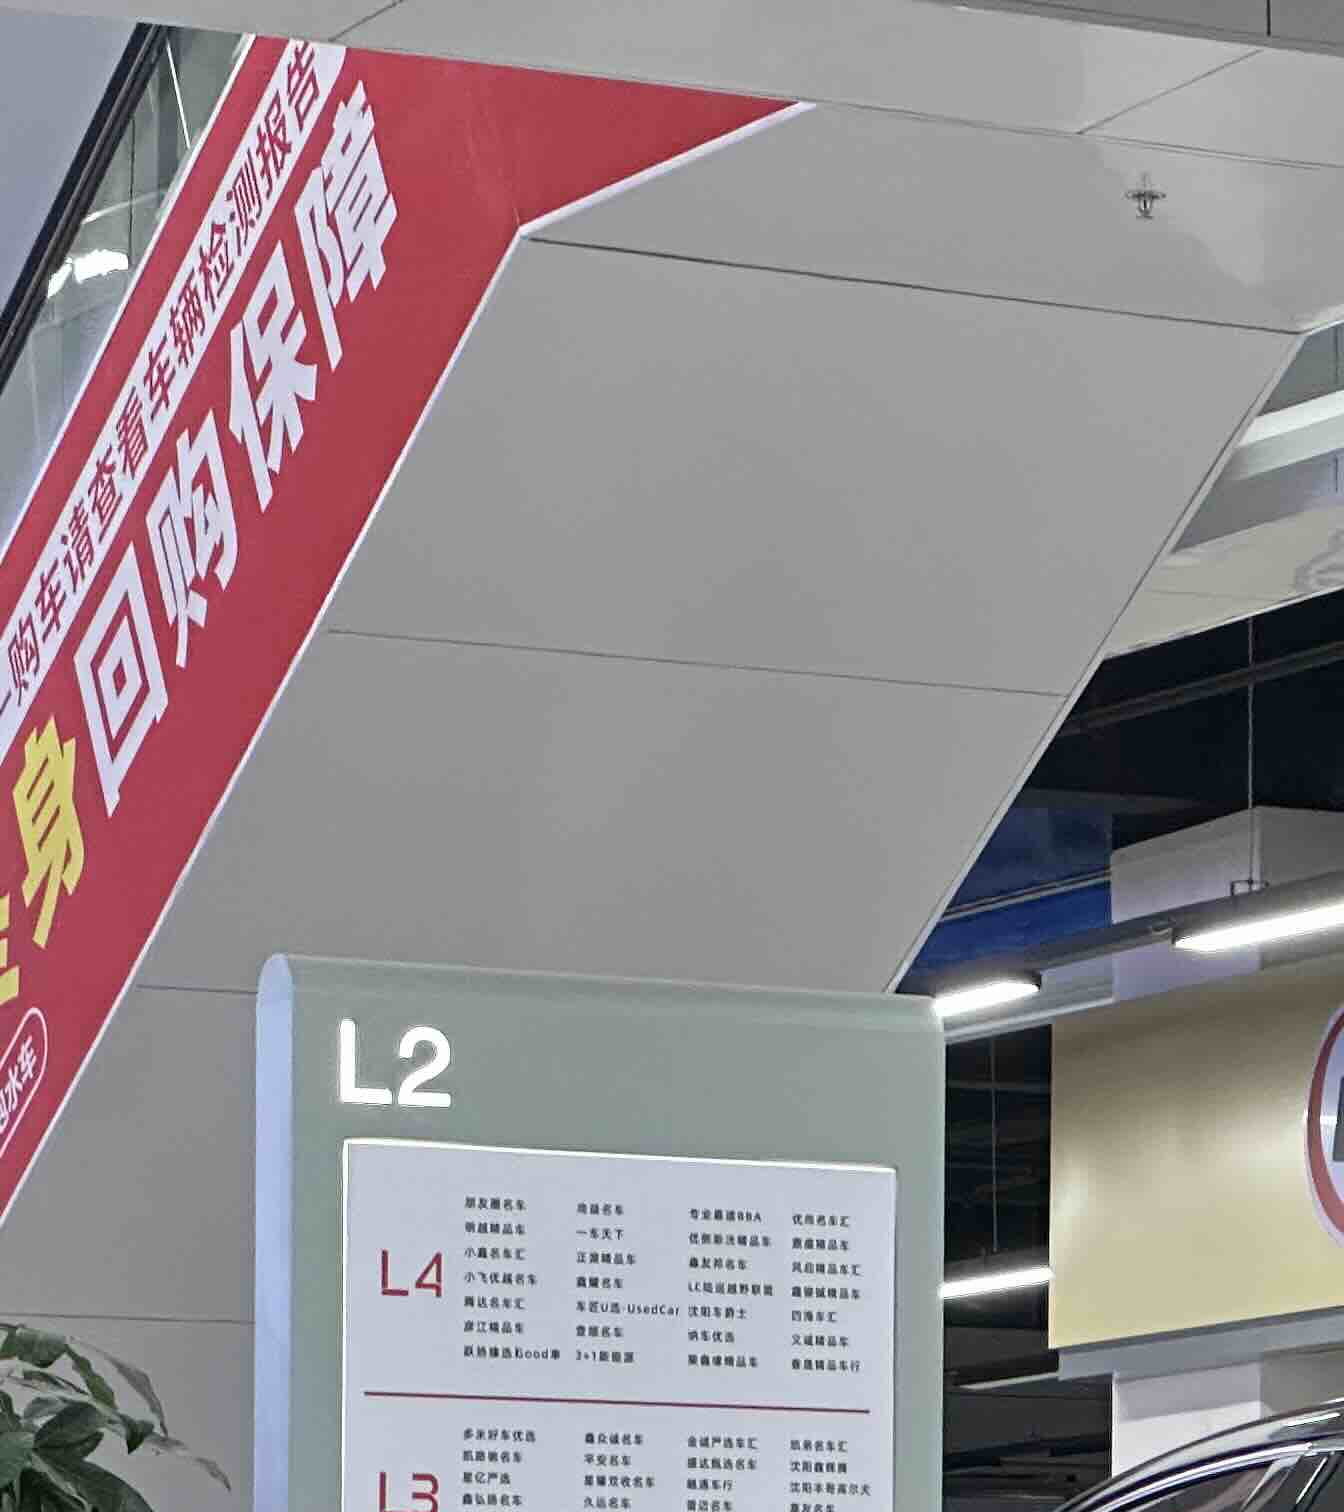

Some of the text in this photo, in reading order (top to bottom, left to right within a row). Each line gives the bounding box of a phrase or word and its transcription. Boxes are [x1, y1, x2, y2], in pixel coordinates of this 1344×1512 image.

[0, 80, 398, 1005] 身回购保障
[339, 1018, 452, 1108] L2
[380, 1249, 443, 1298] L4
